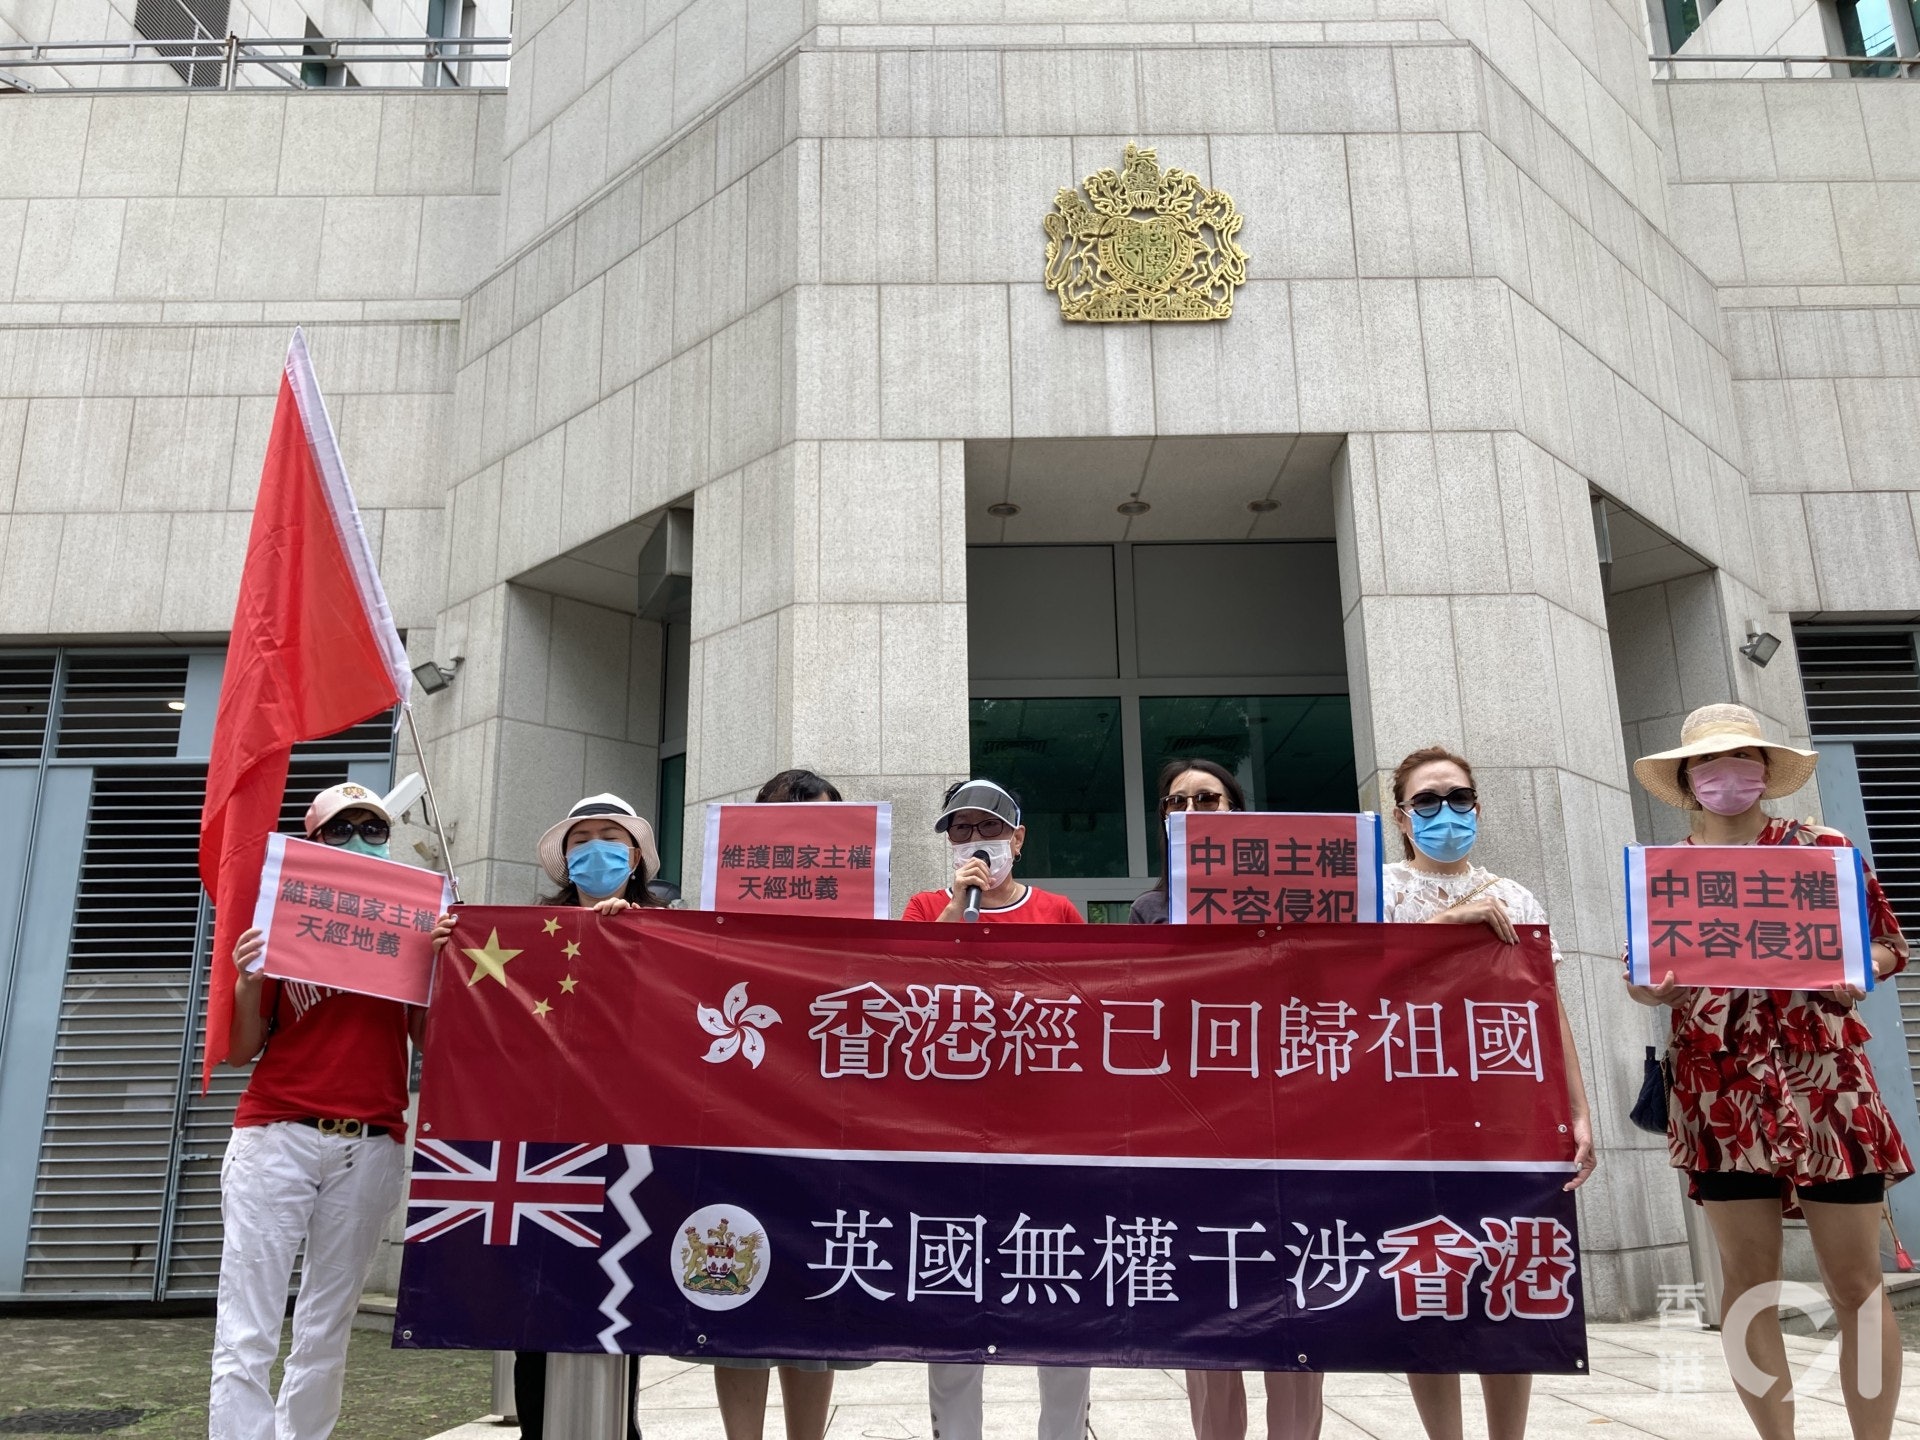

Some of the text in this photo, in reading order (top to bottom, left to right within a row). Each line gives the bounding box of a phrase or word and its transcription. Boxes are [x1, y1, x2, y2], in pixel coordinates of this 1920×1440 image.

[1091, 310, 1136, 319] DIEU ET
[1156, 310, 1208, 319] MON DROIT
[720, 844, 872, 870] 維護國家主權
[1189, 836, 1357, 878] 中國主權
[280, 878, 437, 933] 維護國家主權
[738, 875, 839, 901] 天經地義
[1189, 886, 1357, 923] 不容侵犯
[1650, 869, 1839, 911] 中國主權
[295, 914, 401, 957] 天經地義
[1651, 918, 1842, 961] 不容侵犯
[808, 981, 1545, 1083] 香港經已回歸祖國
[804, 1209, 1575, 1322] 英國無權干涉香港
